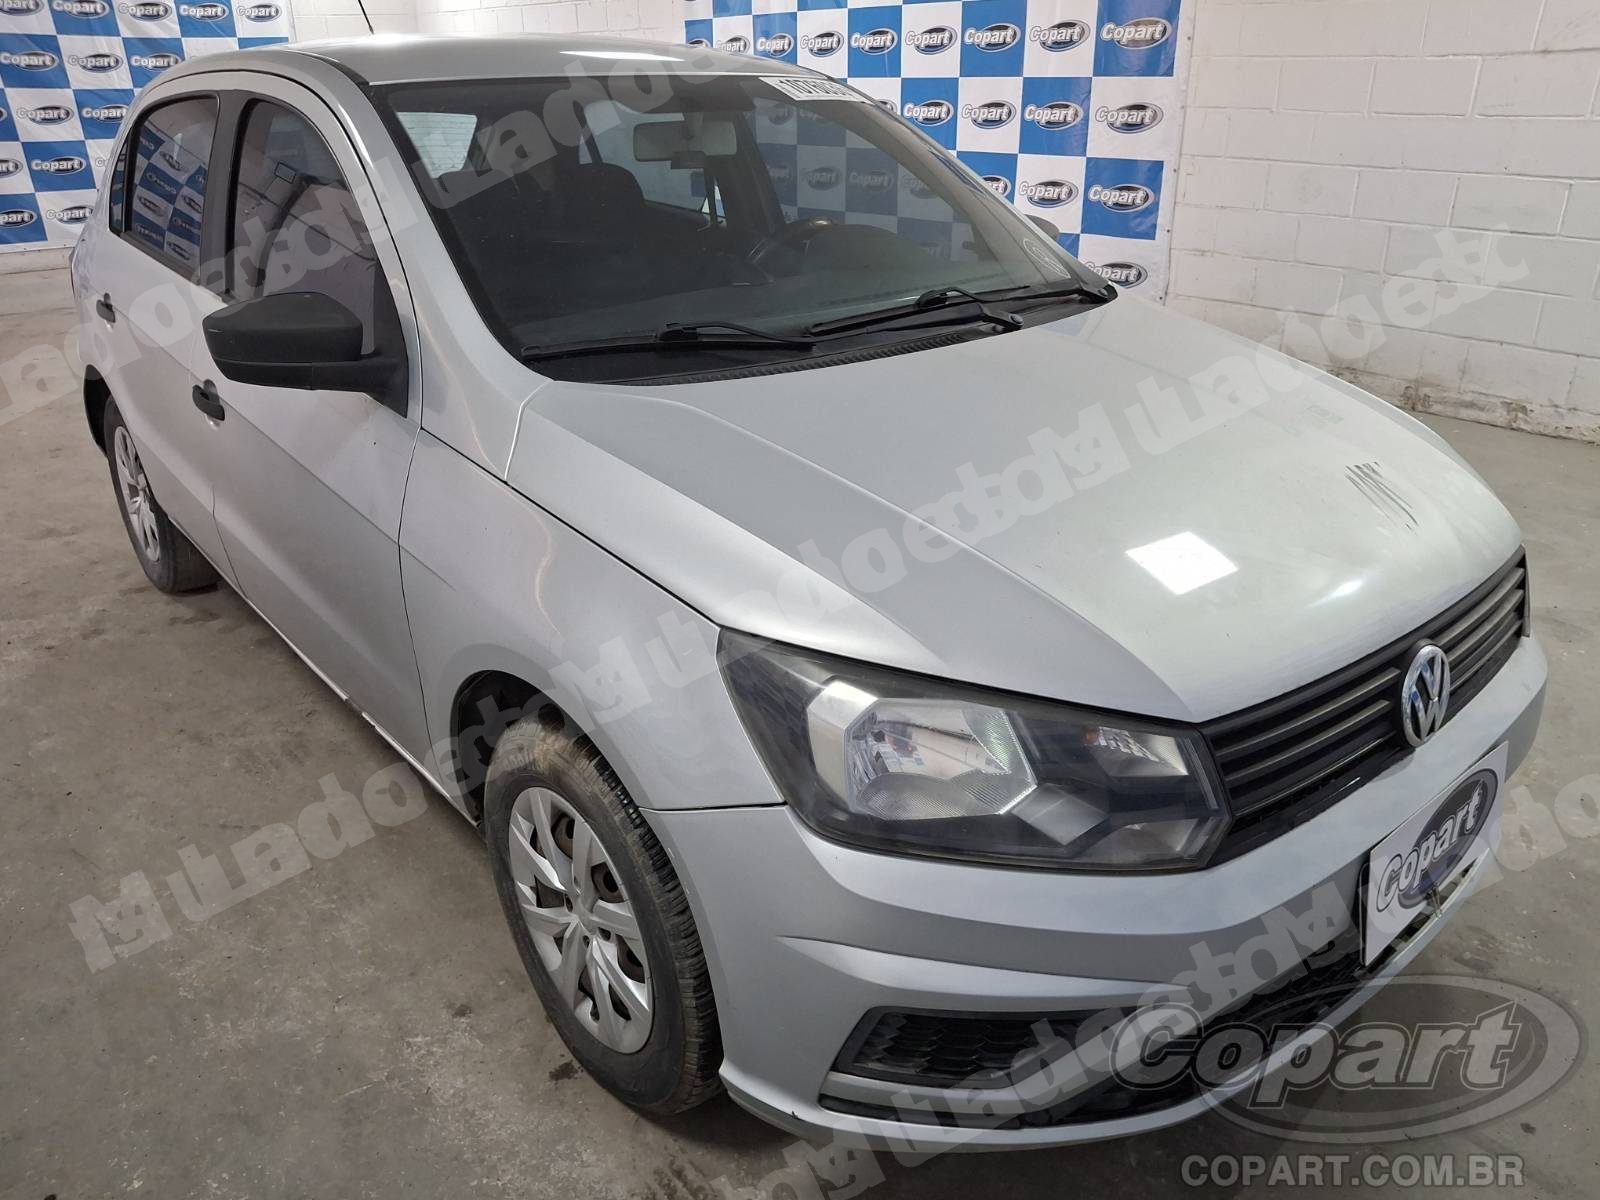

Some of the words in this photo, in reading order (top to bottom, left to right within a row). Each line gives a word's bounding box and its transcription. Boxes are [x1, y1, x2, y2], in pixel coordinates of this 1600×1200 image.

[118, 3, 164, 16] Copart
[179, 5, 223, 17] Copart
[236, 5, 277, 17] Copart
[905, 31, 950, 50] Copart
[964, 28, 1015, 46] Copart
[1029, 25, 1081, 48] Copart
[1101, 22, 1163, 43] Copart
[757, 37, 788, 53] Copart
[800, 35, 838, 53] Copart
[851, 32, 894, 51] Copart
[0, 52, 51, 67] Copart
[68, 54, 115, 69] Copart
[131, 55, 175, 68] Copart
[16, 107, 67, 121] Copart
[904, 103, 947, 120] Copart
[962, 104, 1008, 121] Copart
[1024, 105, 1075, 123] Copart
[1095, 106, 1152, 127] Copart
[31, 159, 80, 172] Copart
[1019, 182, 1070, 202] Copart
[1089, 186, 1147, 207] Copart
[47, 208, 91, 221] Copart
[1377, 778, 1484, 912] Copart
